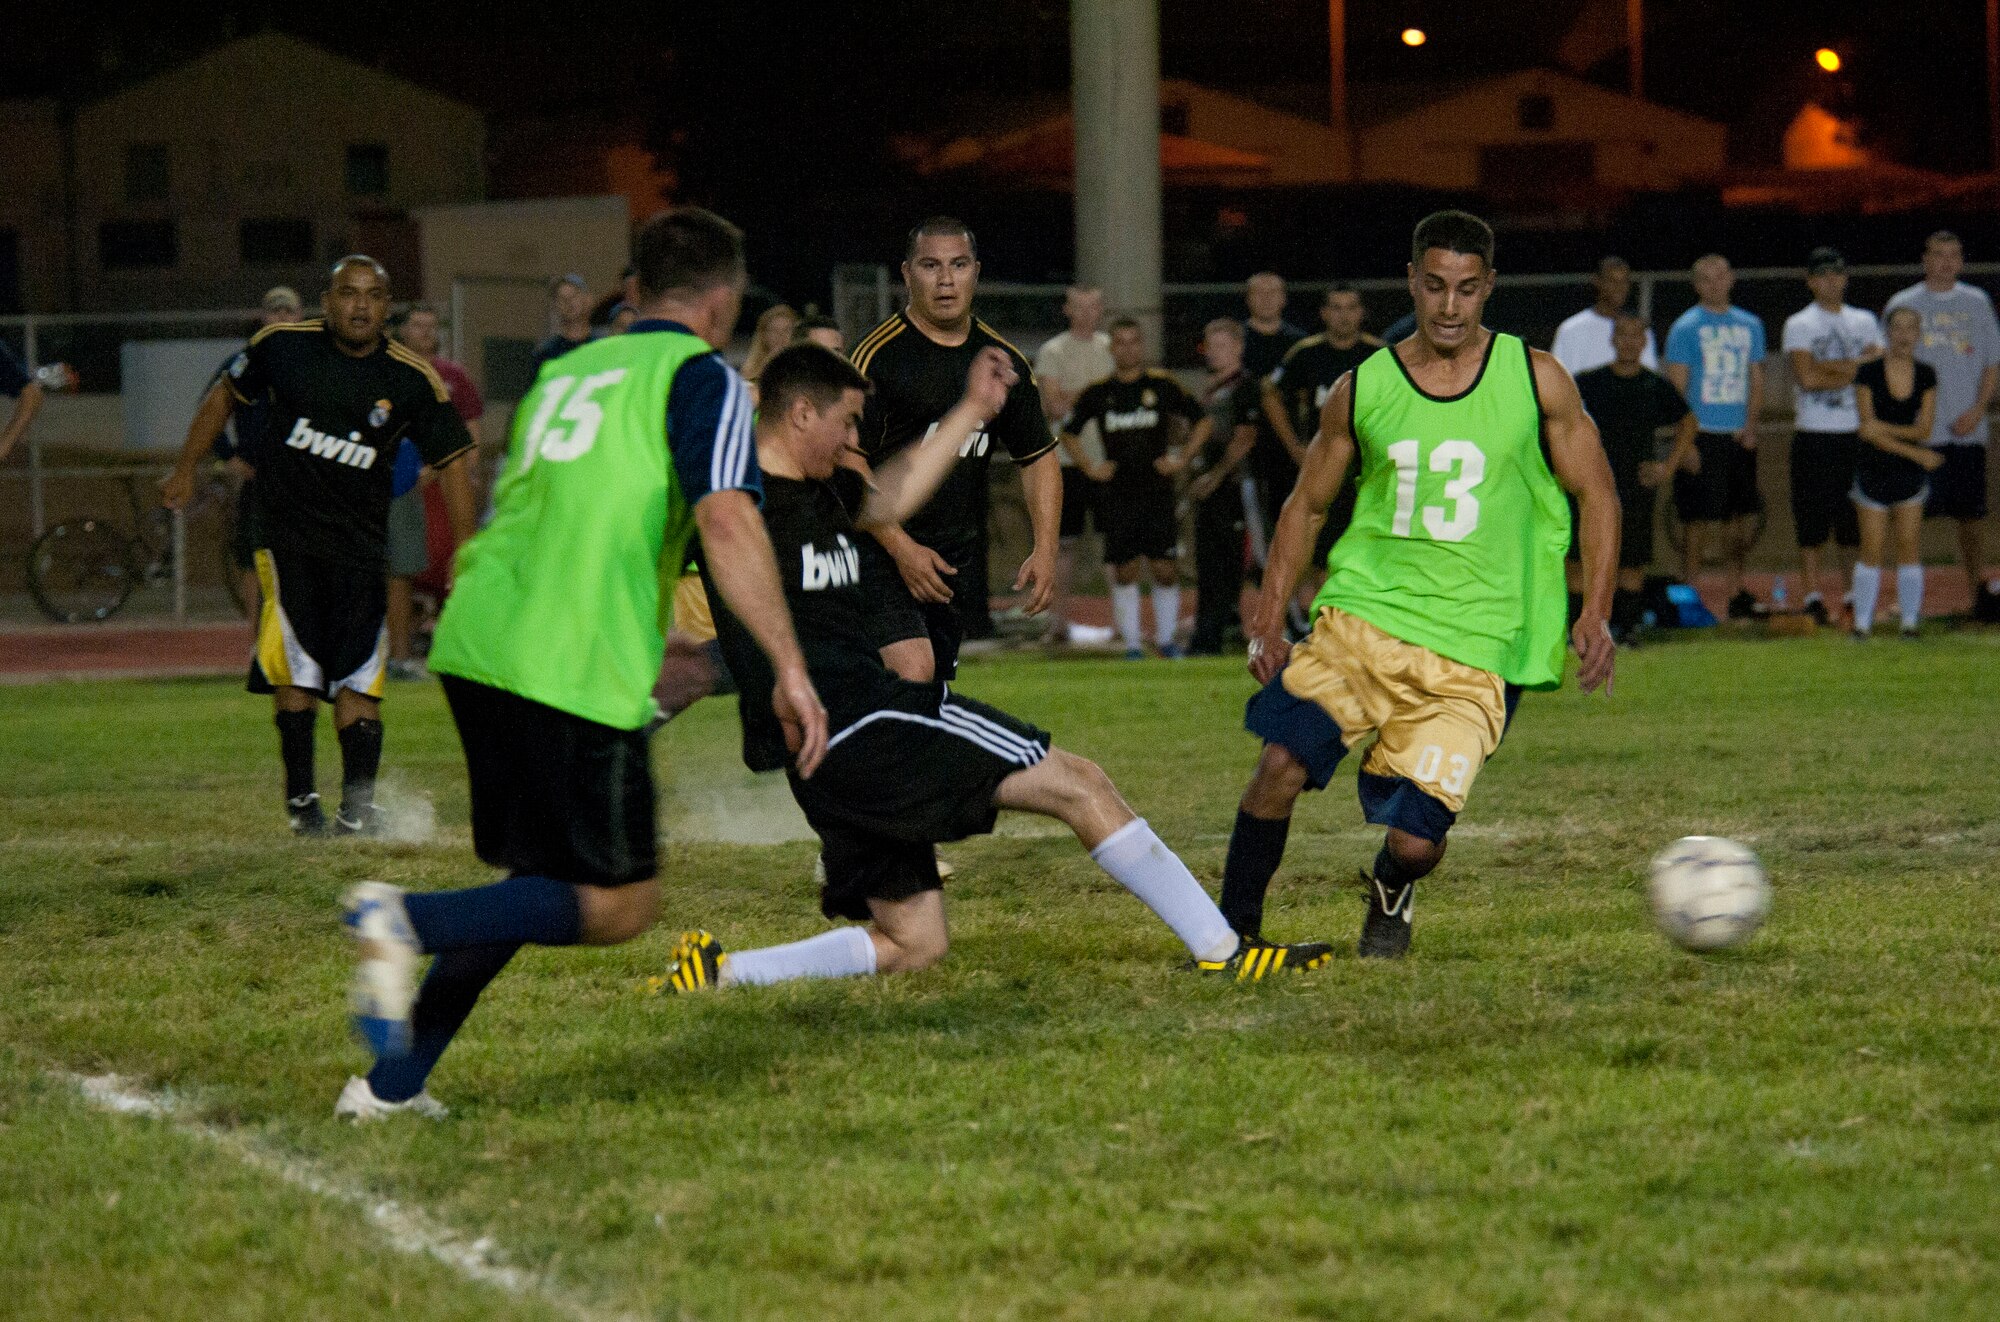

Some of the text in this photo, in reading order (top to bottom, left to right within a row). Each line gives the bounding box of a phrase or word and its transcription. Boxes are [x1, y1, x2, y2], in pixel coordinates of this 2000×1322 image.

[285, 417, 378, 470] bwin
[518, 368, 627, 476] 15
[1387, 439, 1486, 542] 13
[1413, 744, 1470, 796] 03
